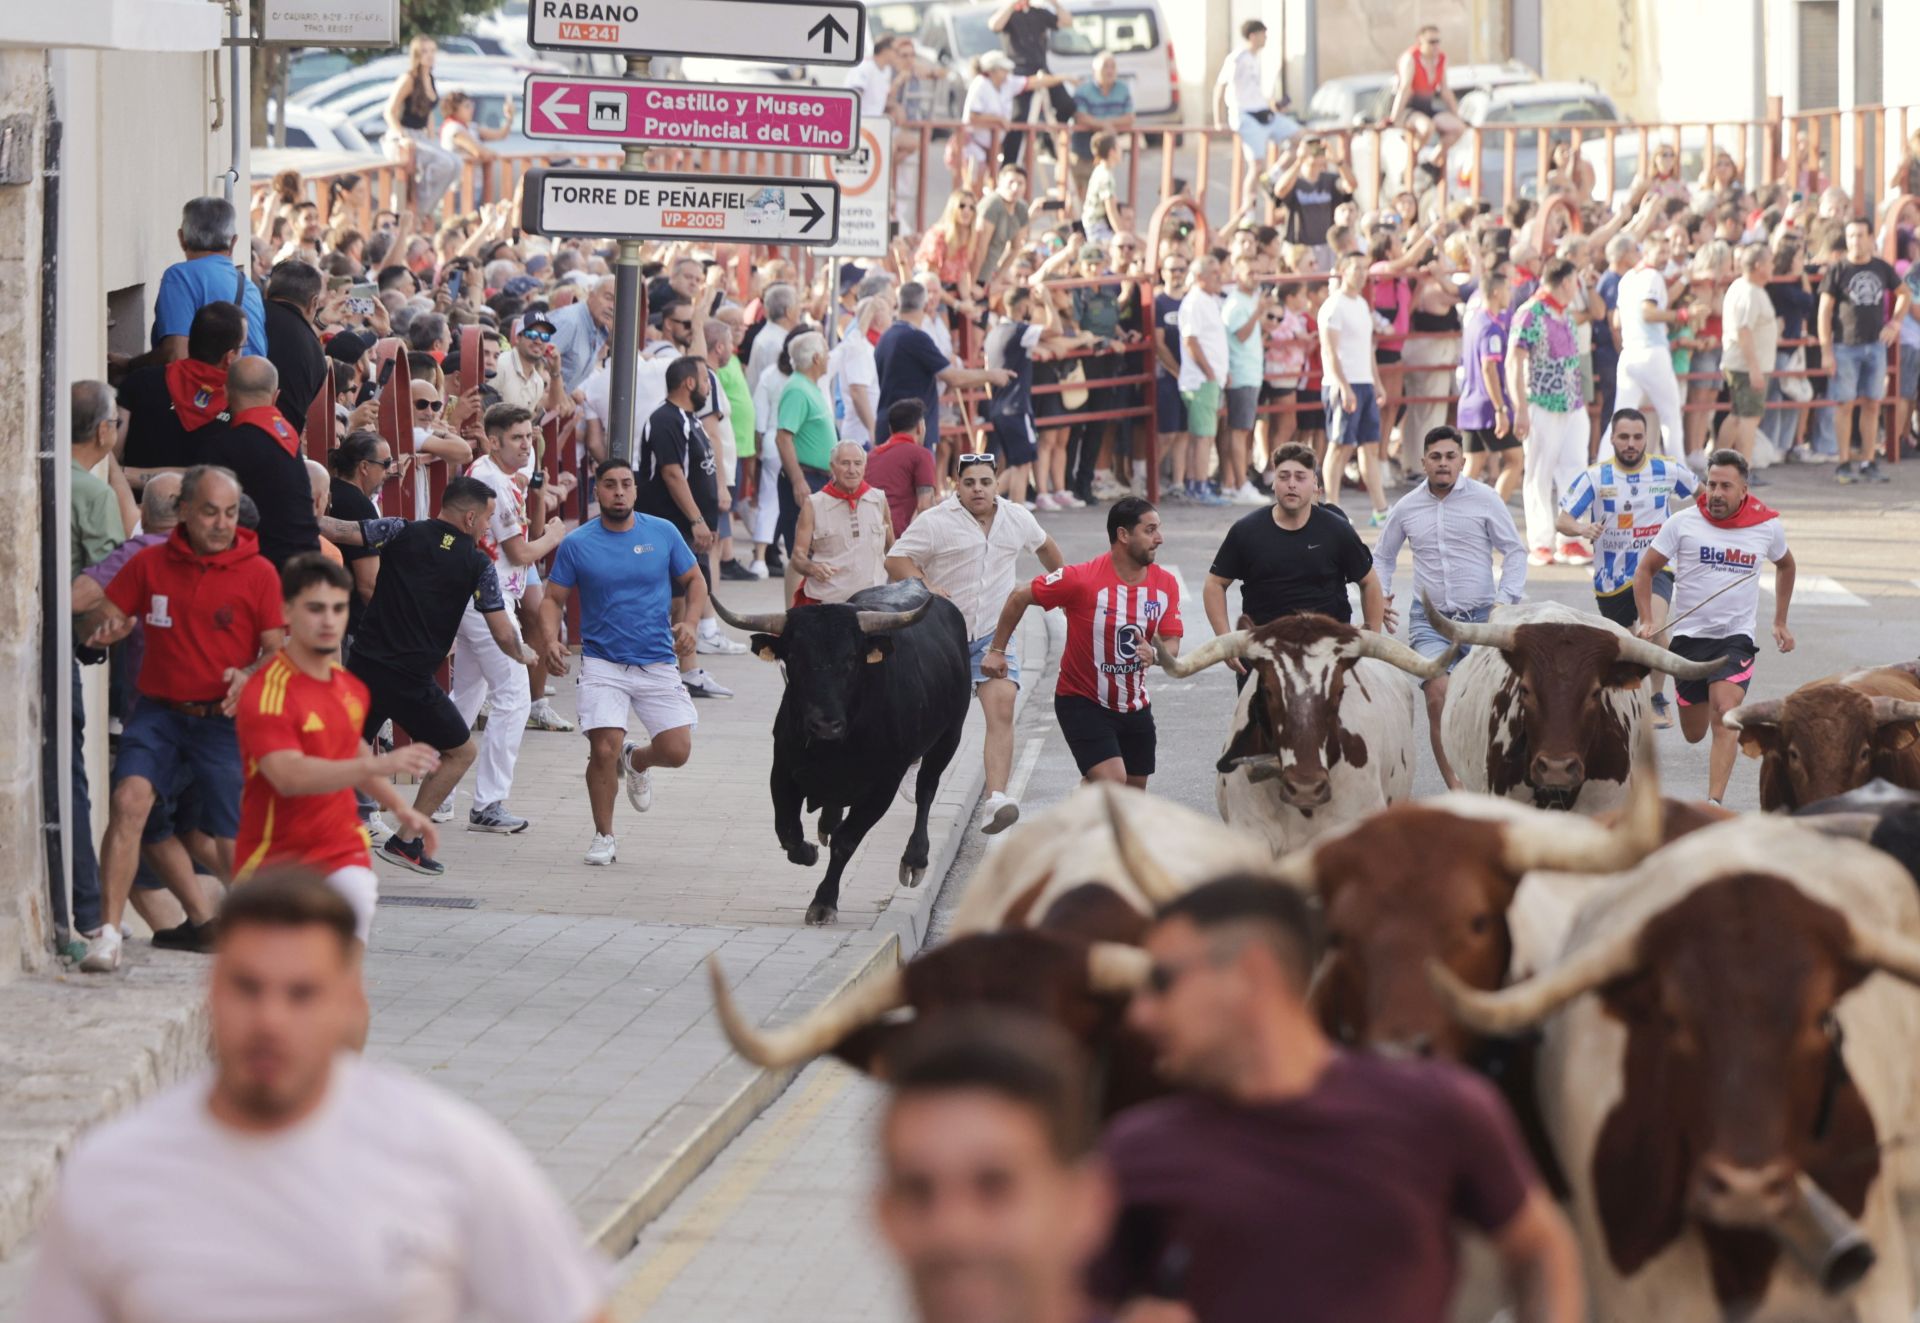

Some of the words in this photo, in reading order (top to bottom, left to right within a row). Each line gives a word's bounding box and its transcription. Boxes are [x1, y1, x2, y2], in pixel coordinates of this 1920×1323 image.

[561, 24, 617, 41] VA-241
[646, 91, 729, 112] Castillo
[736, 99, 748, 117] y
[756, 96, 825, 117] Museo
[644, 117, 748, 139] Provincial
[757, 124, 790, 142] del
[799, 125, 843, 144] Vino
[551, 186, 617, 205] TORRE
[624, 189, 650, 207] DE
[657, 186, 745, 209] PEÑAFIEL
[664, 212, 724, 227] VP-2005
[840, 208, 873, 217] CEPTO
[1700, 546, 1757, 565] BigMat
[1102, 663, 1138, 674] RIYADH
